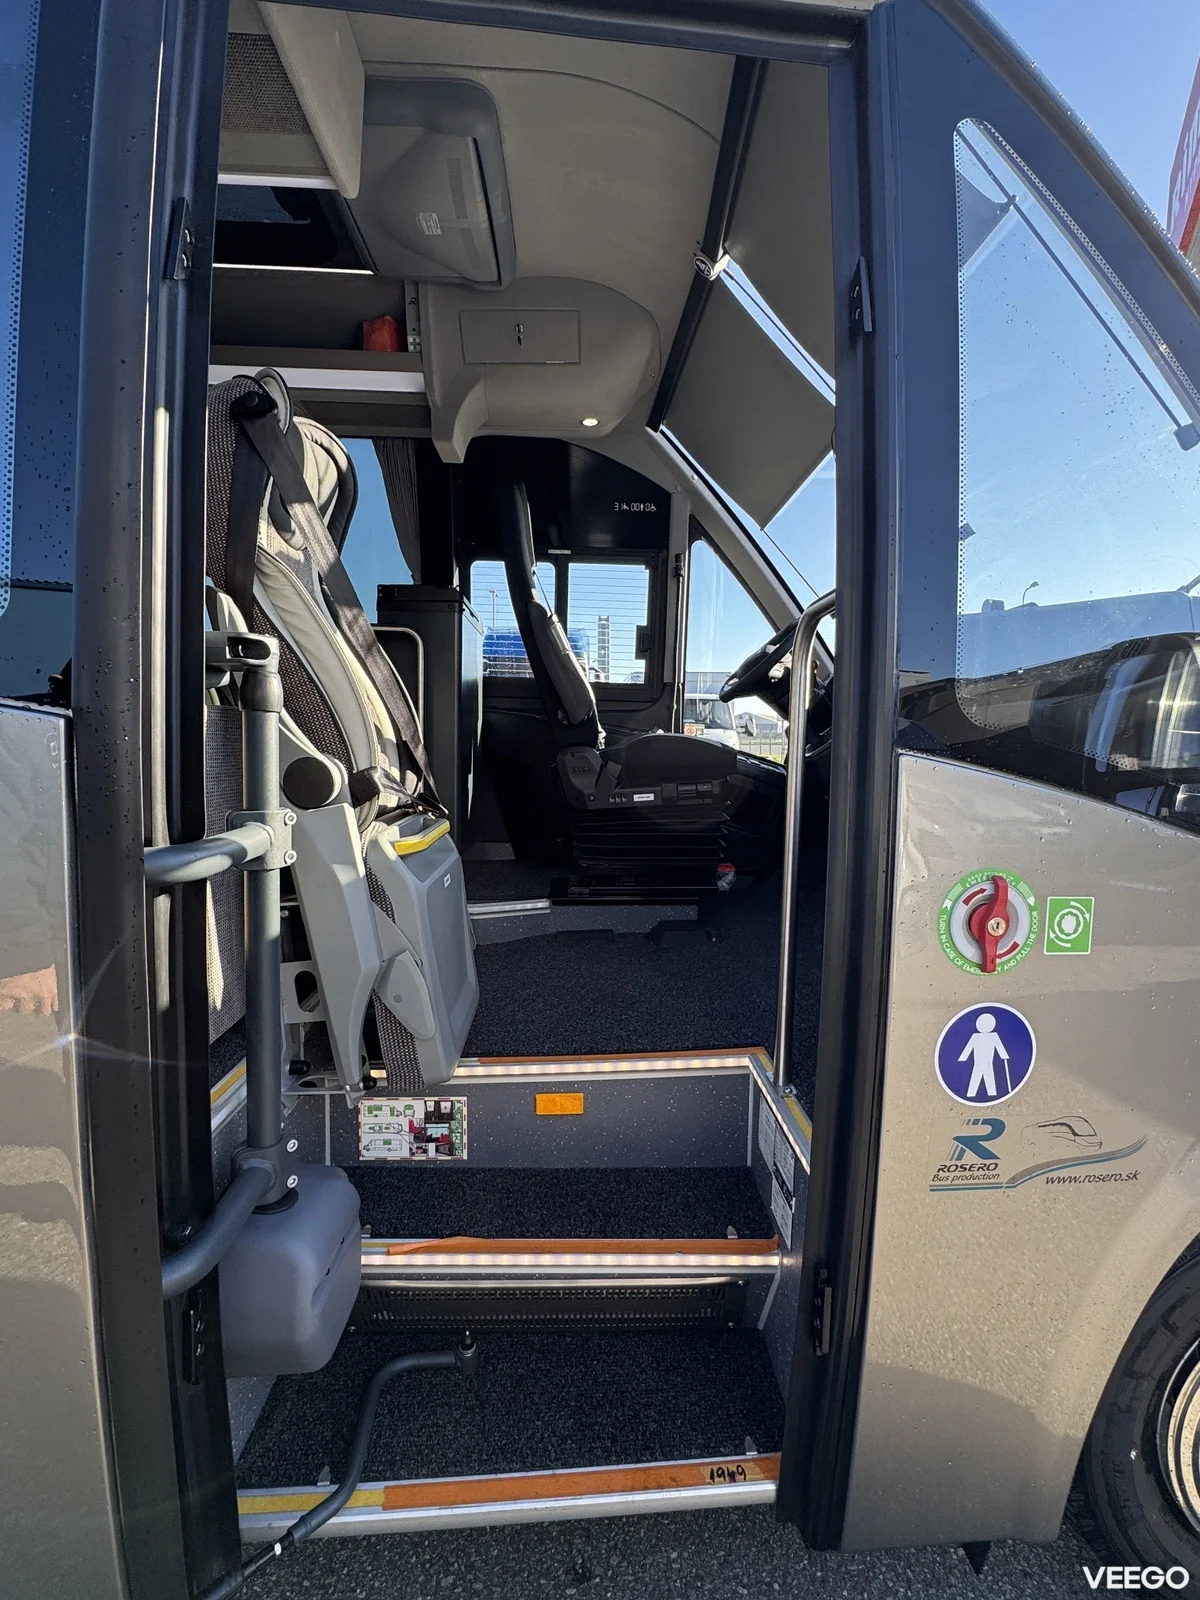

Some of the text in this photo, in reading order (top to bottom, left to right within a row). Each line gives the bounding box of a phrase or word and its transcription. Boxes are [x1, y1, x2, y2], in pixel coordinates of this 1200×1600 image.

[940, 934, 948, 943] IN
[1027, 933, 1037, 946] THE
[943, 943, 956, 959] CASE
[1016, 946, 1031, 961] PULL
[954, 957, 965, 967] OF
[1004, 959, 1017, 971] AND
[937, 1162, 999, 1173] ROSERO
[932, 1171, 1000, 1184] Bus production
[1045, 1169, 1141, 1185] www.rosero.sk
